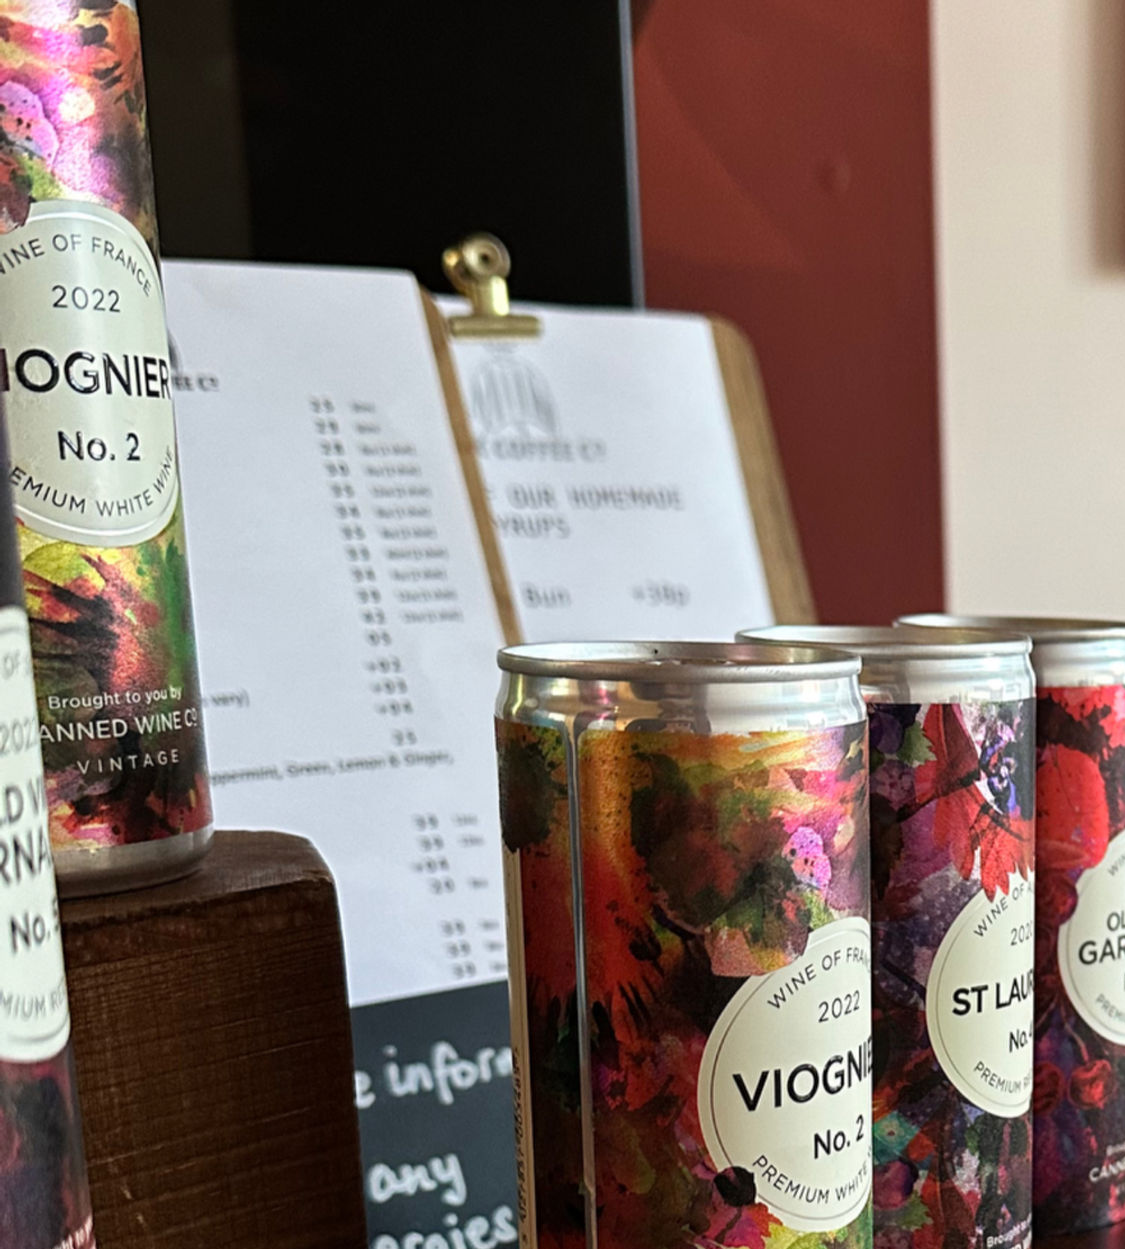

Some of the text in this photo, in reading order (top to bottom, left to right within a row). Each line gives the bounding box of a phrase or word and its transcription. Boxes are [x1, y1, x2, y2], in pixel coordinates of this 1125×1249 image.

[52, 233, 82, 252] OF
[91, 236, 152, 298] FRANCE
[51, 285, 121, 314] 2022
[57, 430, 141, 461] No. 2
[95, 488, 153, 518] WHITE
[153, 445, 174, 495] WINE
[48, 692, 120, 711] Brought
[125, 692, 141, 704] to
[145, 689, 168, 705] you
[169, 684, 182, 700] by
[40, 718, 129, 744] ANNED
[134, 710, 182, 736] WINE
[77, 748, 180, 775] VINTAGE
[973, 894, 1008, 939] WINE
[1011, 882, 1026, 902] OF
[767, 962, 817, 1010] WINE
[821, 949, 842, 972] OF
[817, 989, 861, 1023] 2022
[952, 984, 989, 1016] ST
[973, 1060, 1021, 1094] PREMIUM
[813, 1129, 851, 1159] No.
[856, 1114, 865, 1142] 2
[368, 1152, 467, 1206] any
[752, 1155, 868, 1205] PREMIUM WHITE
